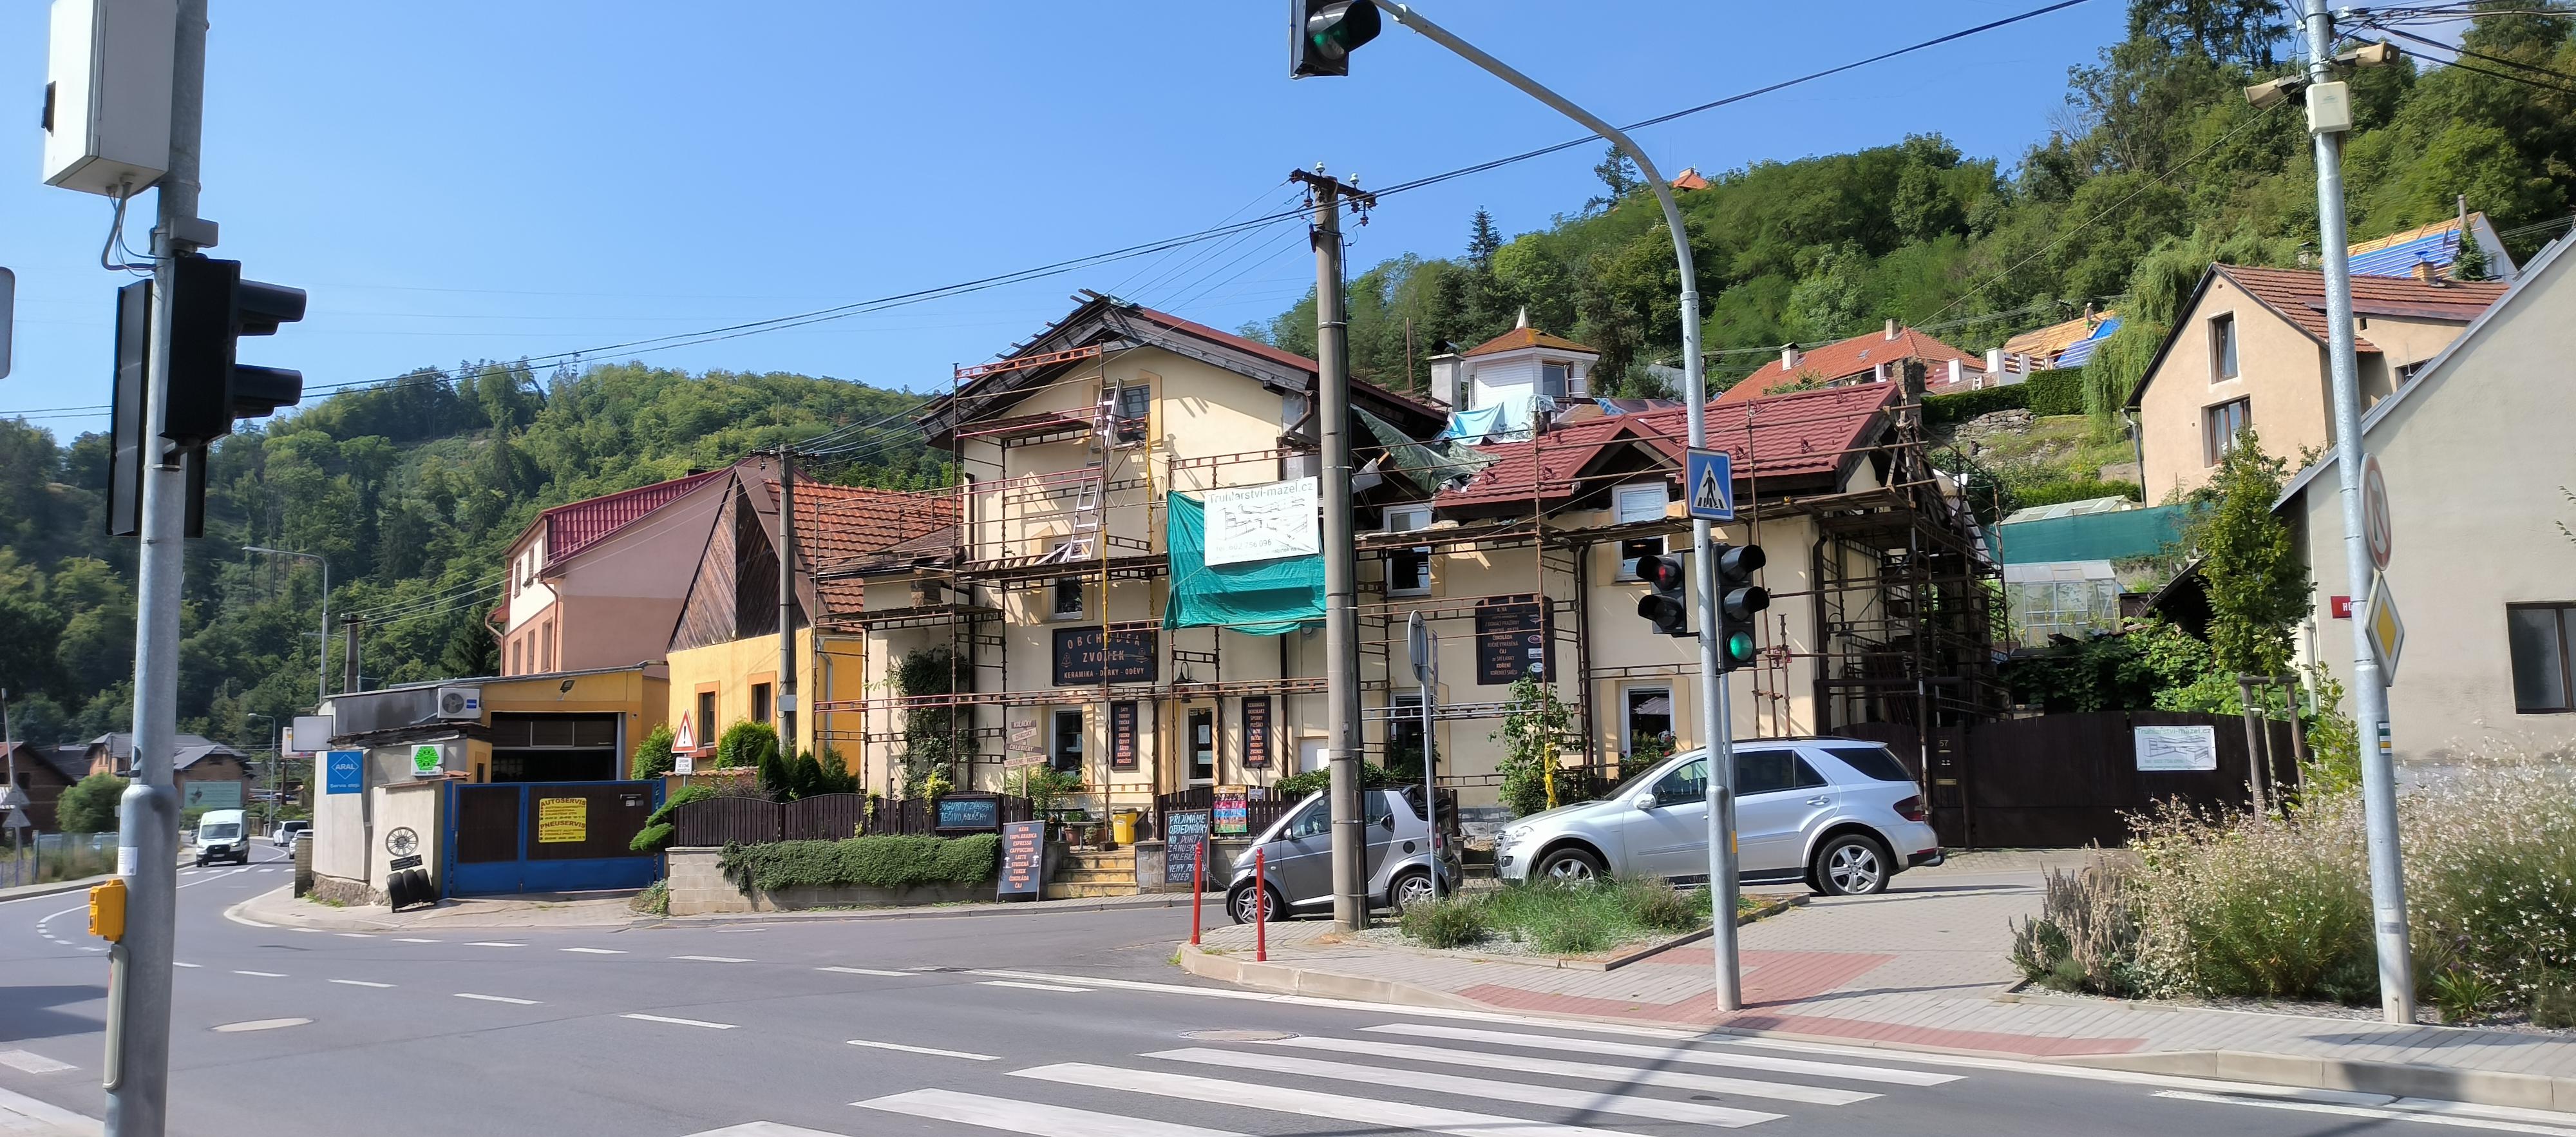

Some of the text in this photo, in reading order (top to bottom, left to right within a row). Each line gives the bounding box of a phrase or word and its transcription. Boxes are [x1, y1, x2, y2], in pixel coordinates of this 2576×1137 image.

[1064, 670, 1094, 678] KERAMIKA
[541, 798, 586, 807] AUTOSERVIS
[540, 820, 585, 829] PNEUSERVIS
[1168, 823, 1208, 835] OBJEDNÁVKY
